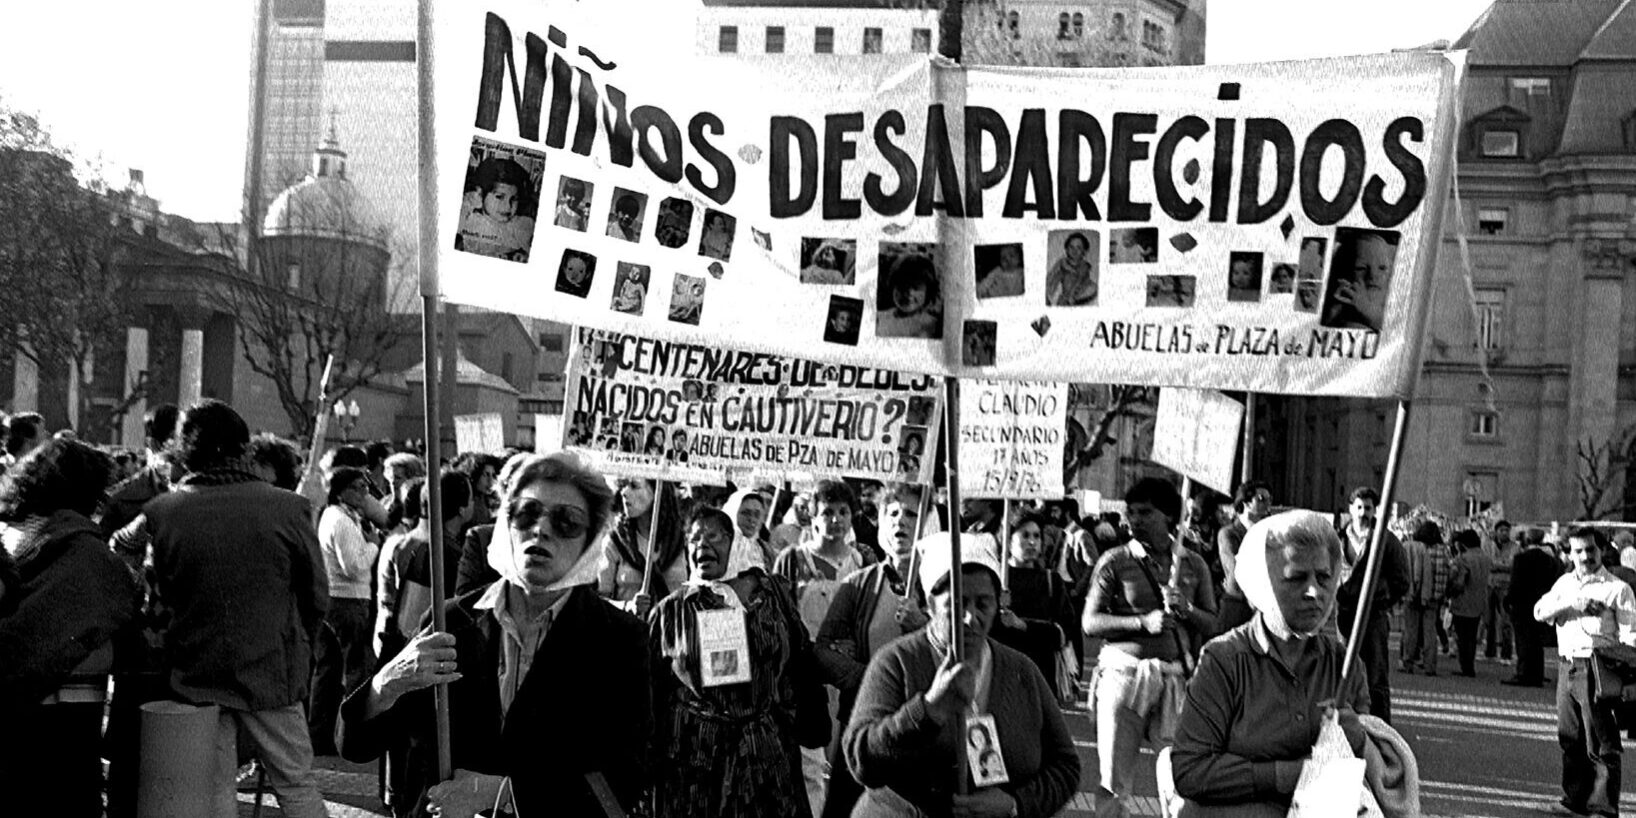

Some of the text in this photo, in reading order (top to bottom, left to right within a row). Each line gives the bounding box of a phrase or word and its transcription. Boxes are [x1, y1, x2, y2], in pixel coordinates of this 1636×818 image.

[476, 12, 1426, 228] NIÑOS DESAPARECIDOS
[1090, 321, 1380, 359] ABUELAS de PLAZA de MAYO
[577, 375, 681, 424] NACIDOS
[686, 402, 713, 429] EN
[979, 390, 1057, 417] CLAUDIO
[689, 433, 762, 461] ABUELAS
[766, 445, 784, 463] DE
[788, 440, 818, 465] PZA
[827, 450, 845, 468] DE
[850, 448, 894, 473] MAYO
[962, 425, 1059, 444] SECUNDARIO
